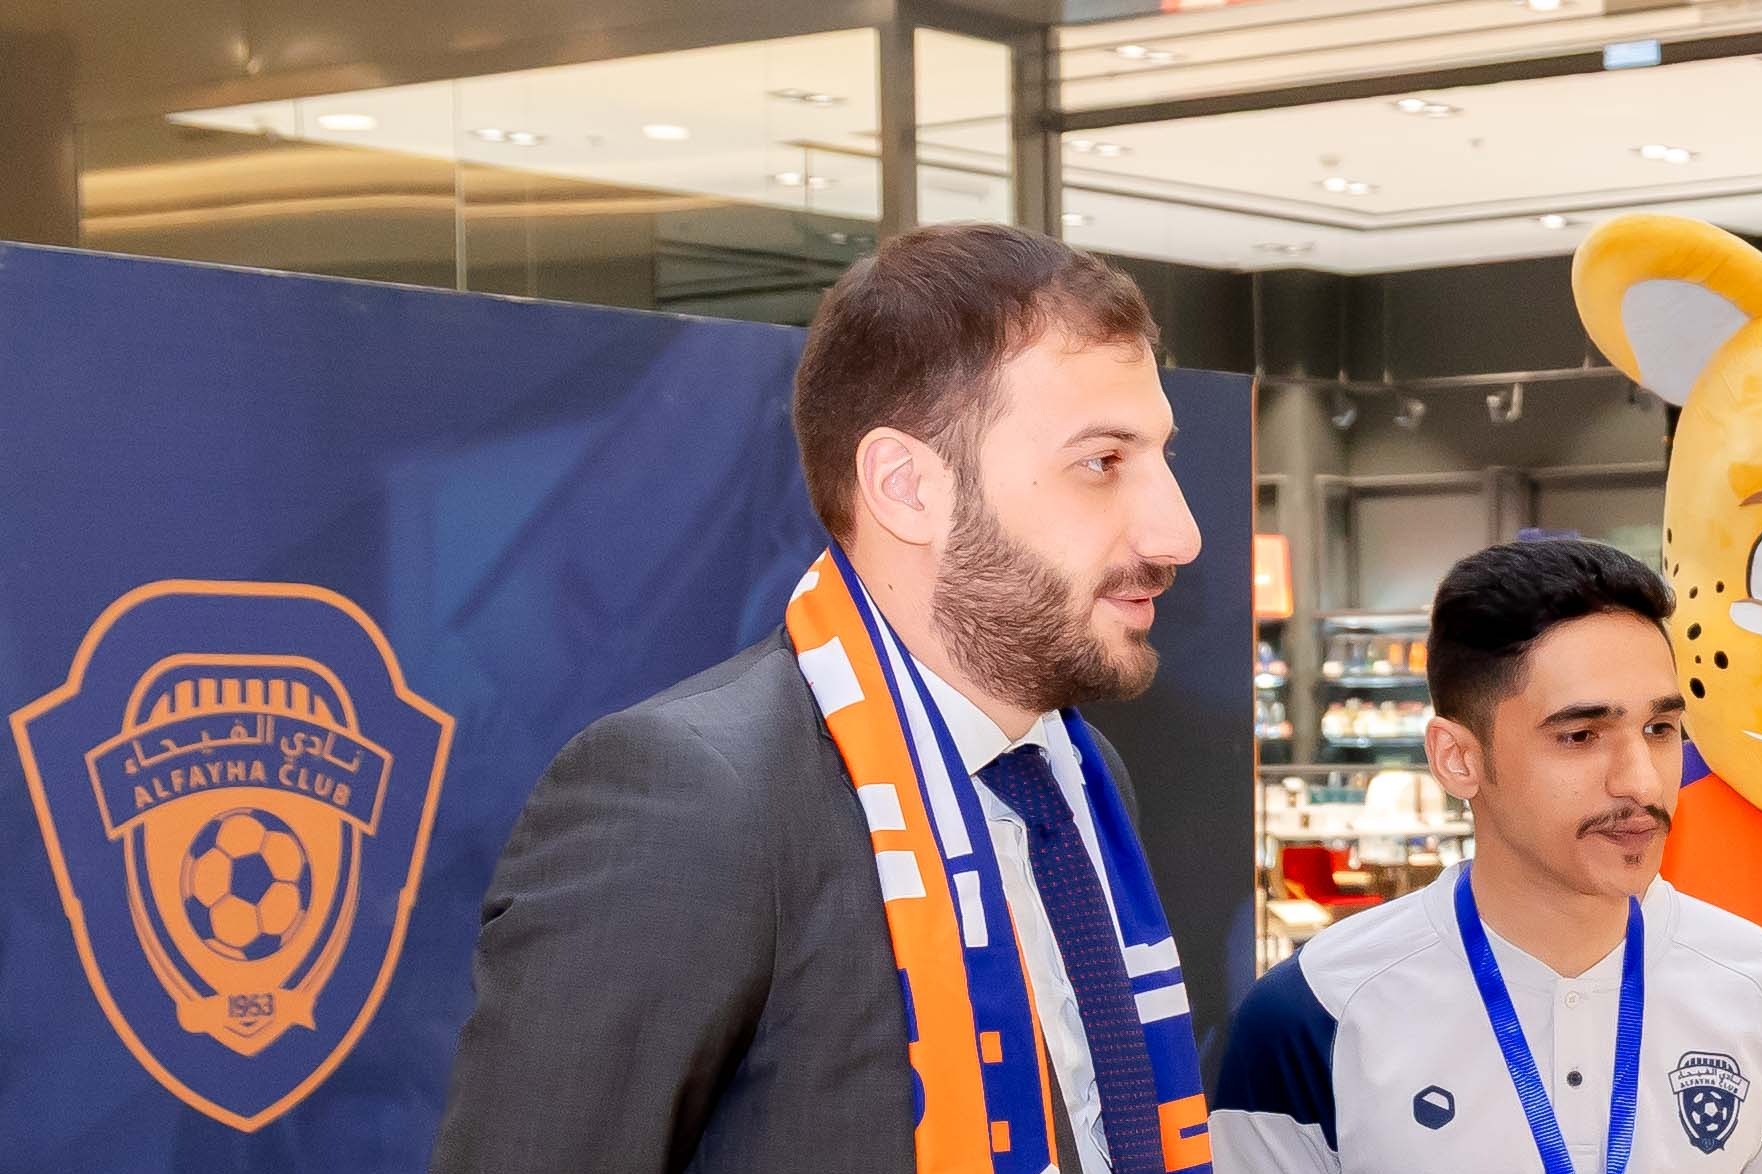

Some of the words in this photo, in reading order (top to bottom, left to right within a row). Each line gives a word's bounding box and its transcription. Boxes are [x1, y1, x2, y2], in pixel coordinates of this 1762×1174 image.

[125, 714, 275, 775] الفيحاء
[280, 731, 362, 773] نادي
[133, 759, 267, 809] ALFAYHA
[278, 763, 351, 807] CLUB
